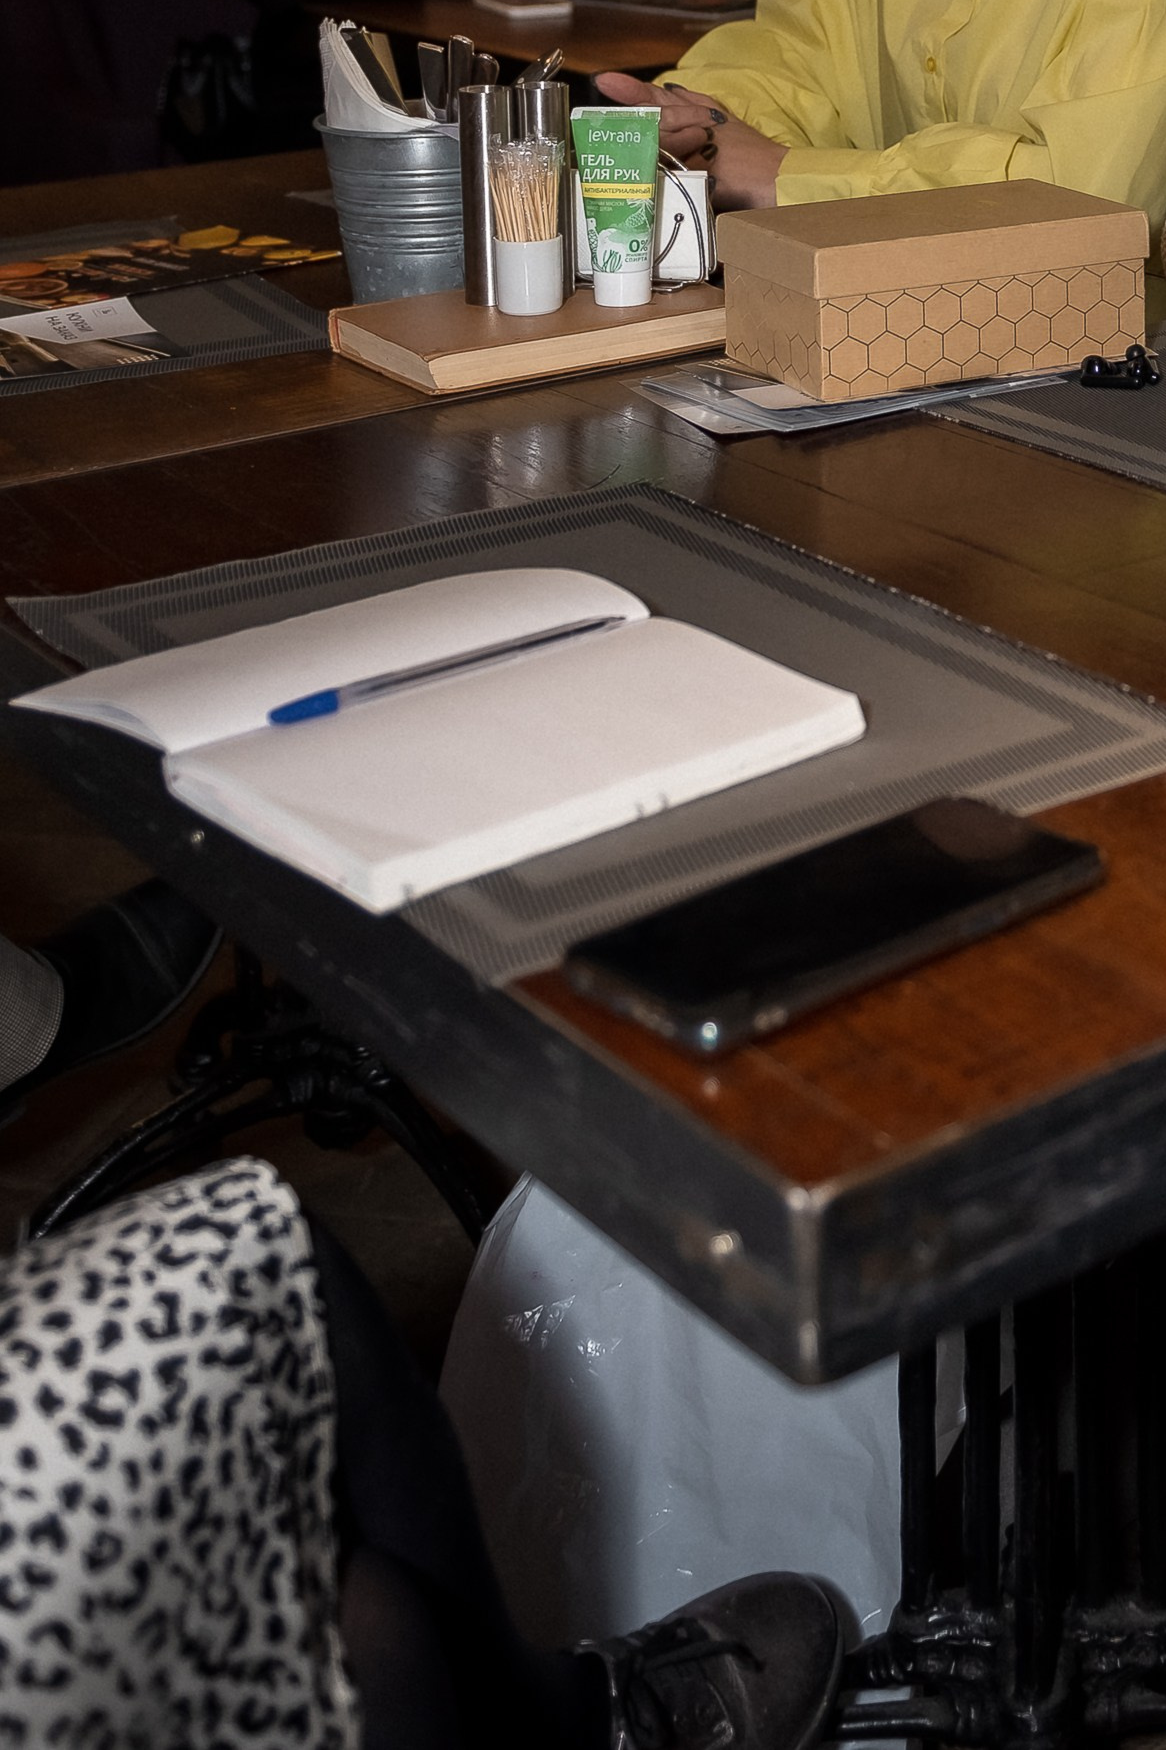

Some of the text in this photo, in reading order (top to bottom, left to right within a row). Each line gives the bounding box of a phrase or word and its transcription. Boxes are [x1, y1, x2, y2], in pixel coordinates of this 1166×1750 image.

[588, 129, 641, 143] levrana
[581, 154, 615, 166] ГЕЛЬ
[583, 169, 640, 182] ДЛЯ РУК
[584, 186, 651, 194] АНТИБАКТЕРИАЛЬНЫЙ
[629, 239, 648, 253] 0%
